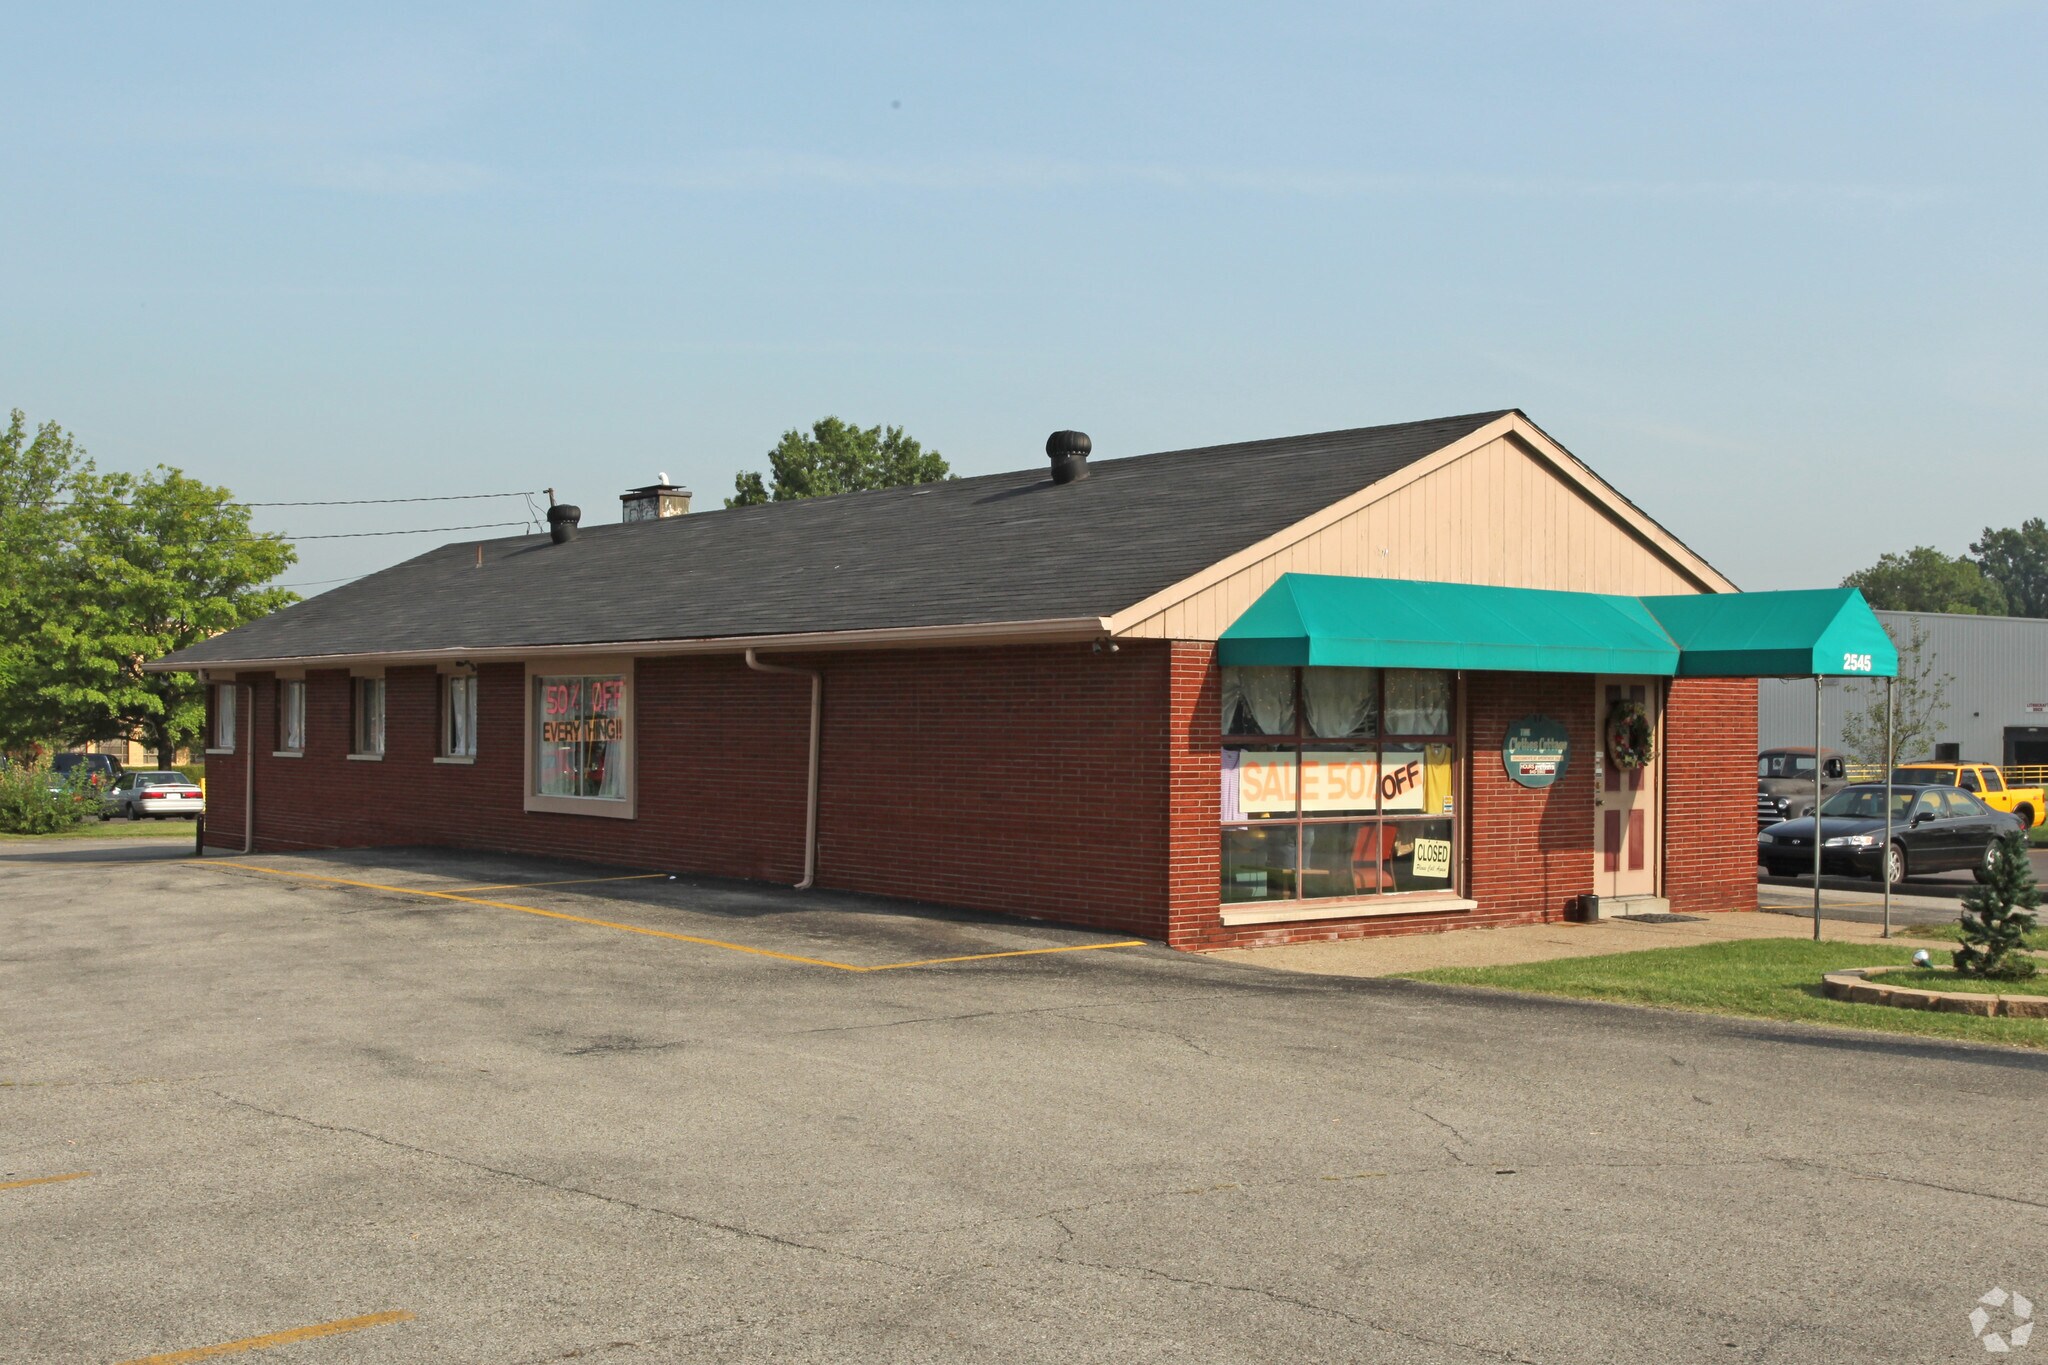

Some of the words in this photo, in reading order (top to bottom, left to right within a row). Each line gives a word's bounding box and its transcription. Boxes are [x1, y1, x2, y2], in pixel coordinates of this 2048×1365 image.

[1843, 653, 1871, 672] 2545
[546, 684, 580, 715] 50%
[592, 681, 624, 712] OFF
[1243, 760, 1320, 802] SALE
[1327, 759, 1381, 800] 50%
[1381, 760, 1419, 800] OFF
[1417, 843, 1448, 863] CLOSED
